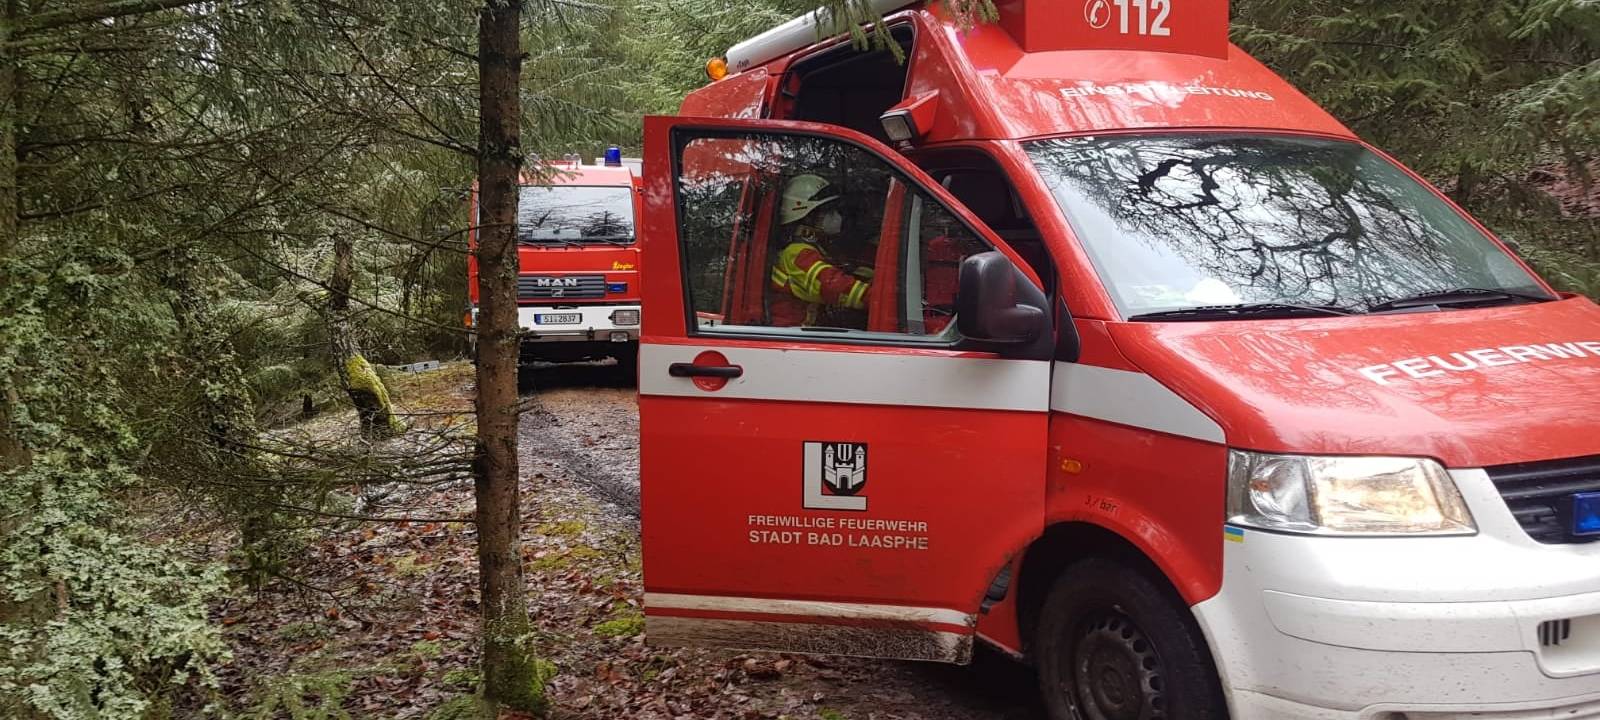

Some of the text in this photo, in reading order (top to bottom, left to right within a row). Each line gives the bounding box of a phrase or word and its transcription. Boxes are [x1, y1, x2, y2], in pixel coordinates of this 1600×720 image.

[1113, 0, 1171, 36] 112
[1059, 83, 1274, 101] EINSALEITUNG
[537, 278, 577, 287] MAN
[748, 515, 928, 532] FREIWILLIGE FEUERWEHR
[749, 530, 929, 550] STADT BAD LAASPHE
